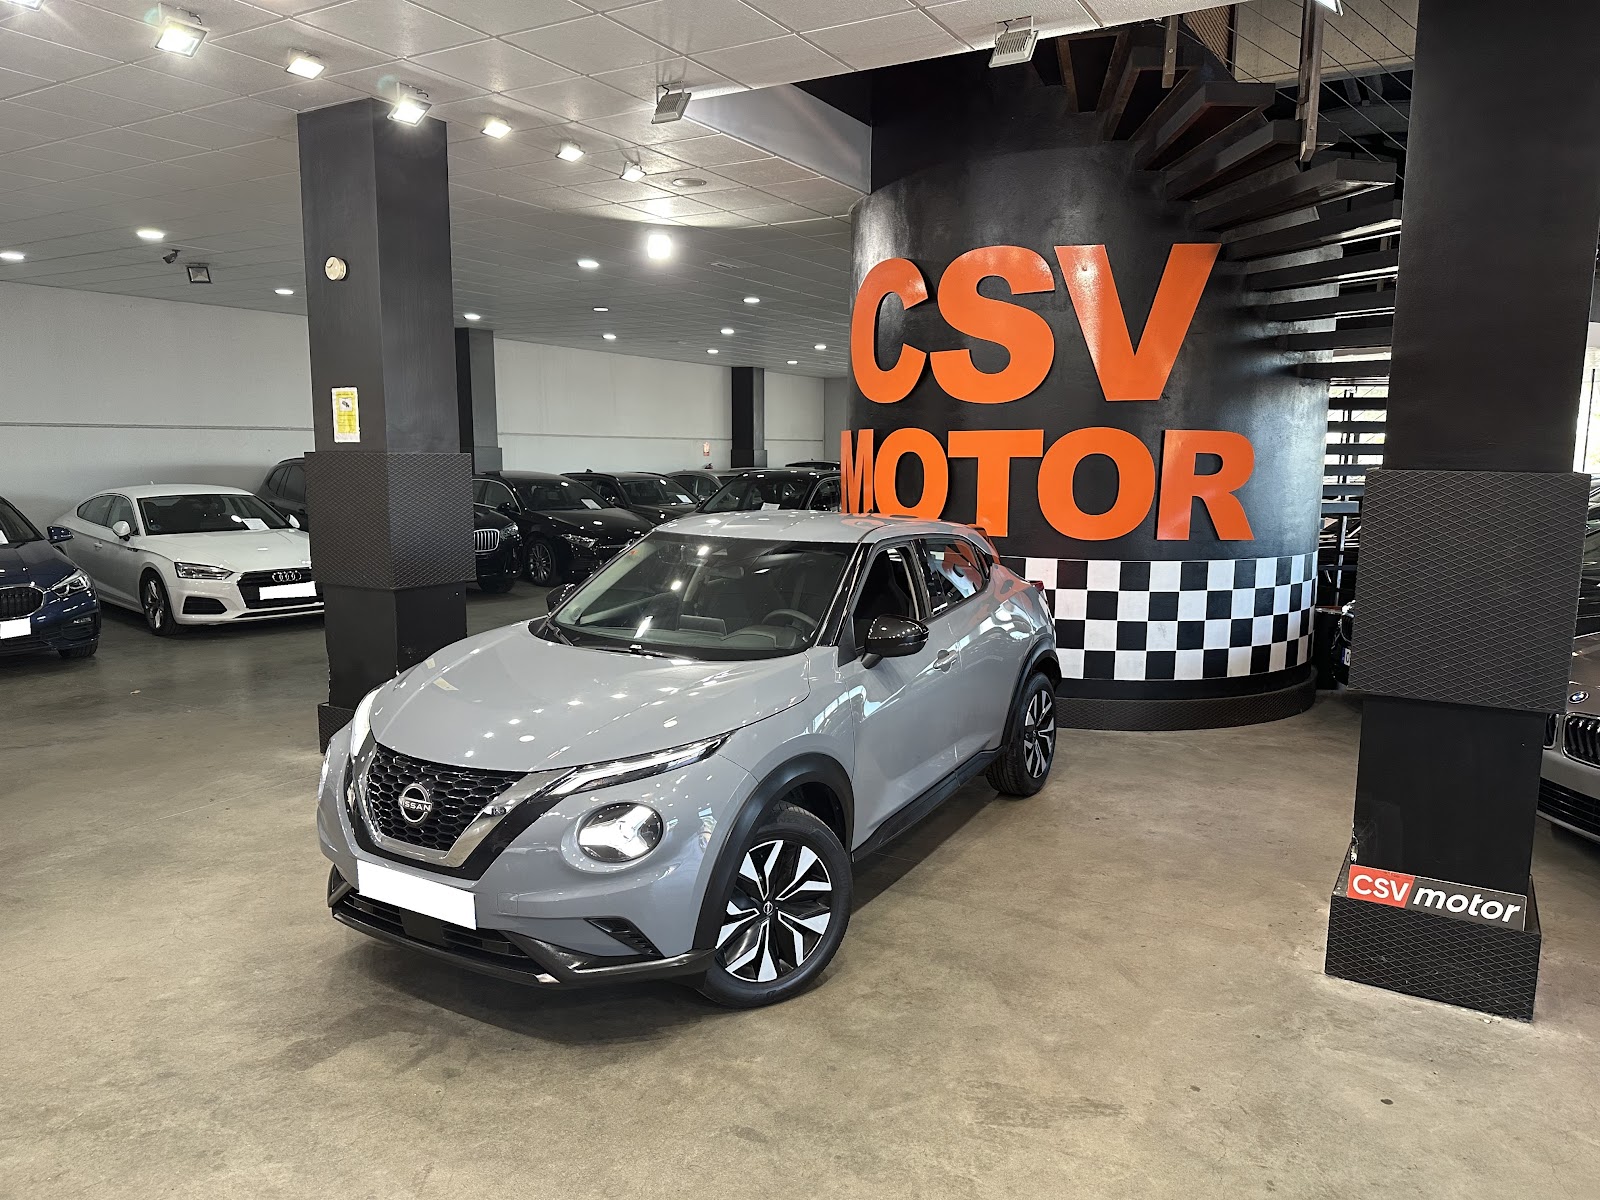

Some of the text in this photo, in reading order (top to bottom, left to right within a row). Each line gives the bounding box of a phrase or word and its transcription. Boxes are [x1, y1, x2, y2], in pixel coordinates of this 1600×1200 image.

[850, 243, 1222, 403] CSV
[840, 427, 1256, 541] MOTOR
[1352, 874, 1521, 923] CSV motor
